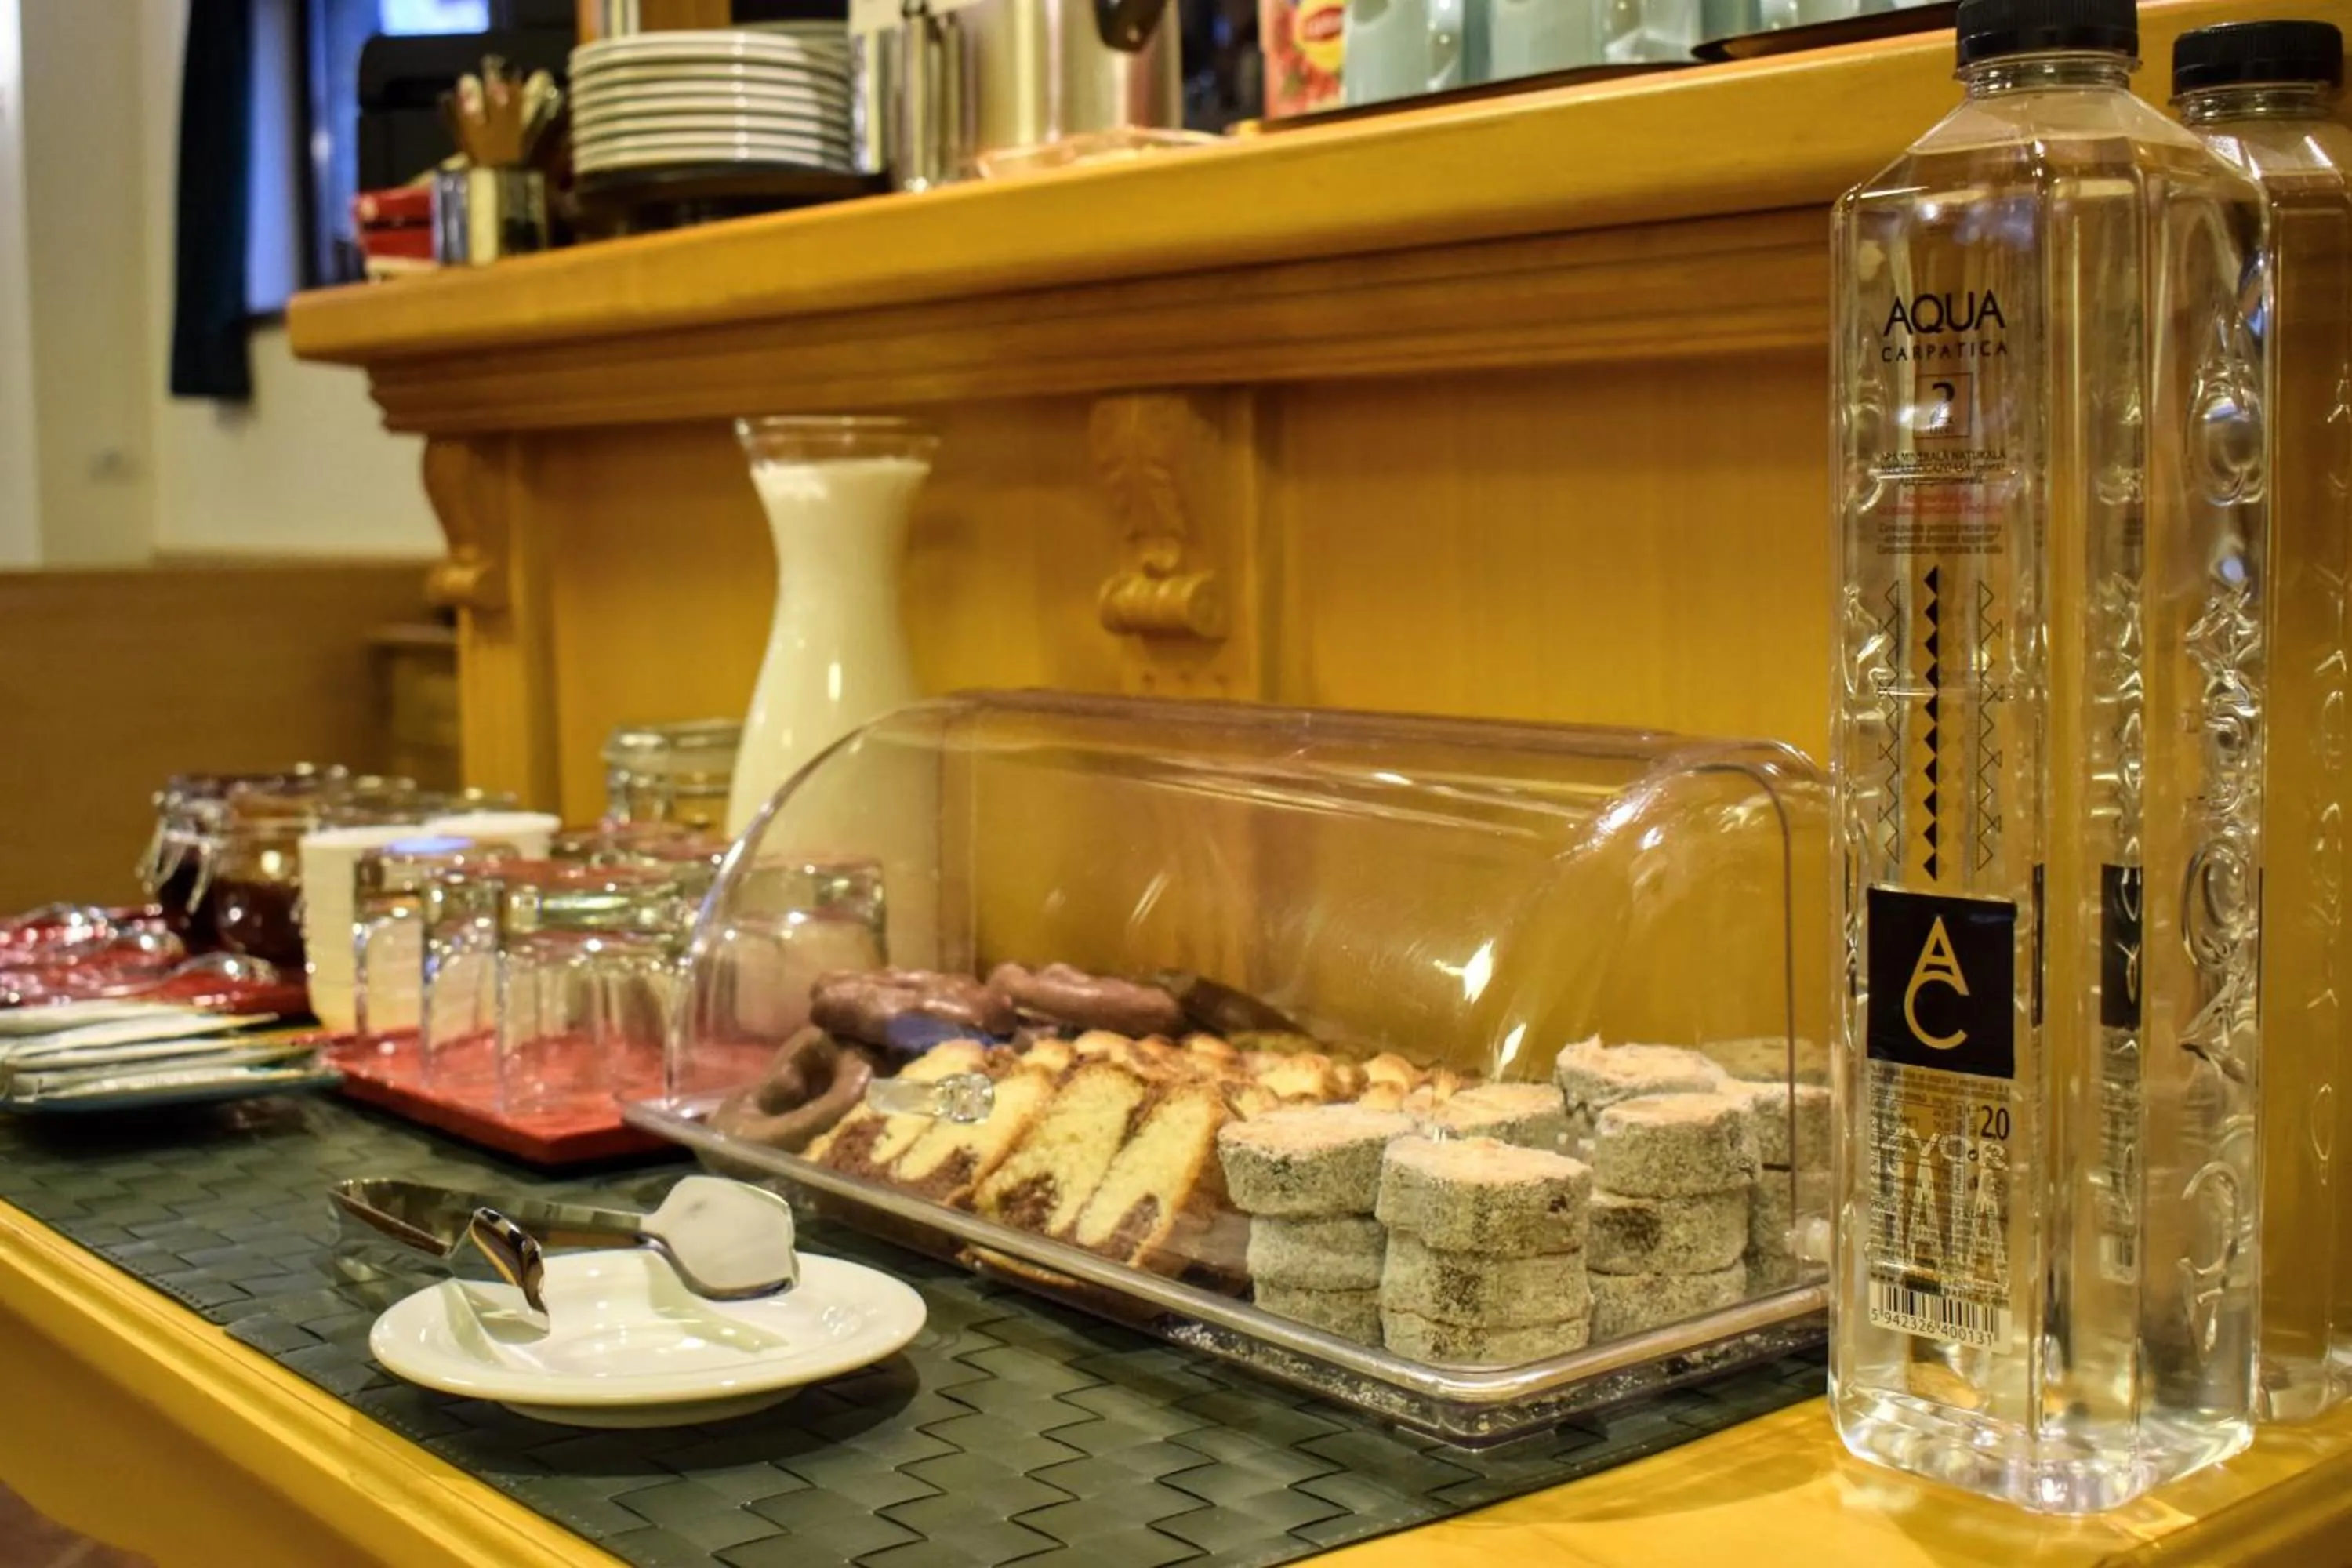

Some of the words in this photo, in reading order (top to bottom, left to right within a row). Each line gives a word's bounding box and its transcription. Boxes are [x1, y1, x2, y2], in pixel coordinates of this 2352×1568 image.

[1883, 289, 2005, 336] AQUA
[1882, 339, 2008, 362] CARPATICA
[1871, 1308, 1878, 1321] 5
[1884, 1312, 1936, 1333] 942326
[1940, 1326, 1993, 1346] 400131
